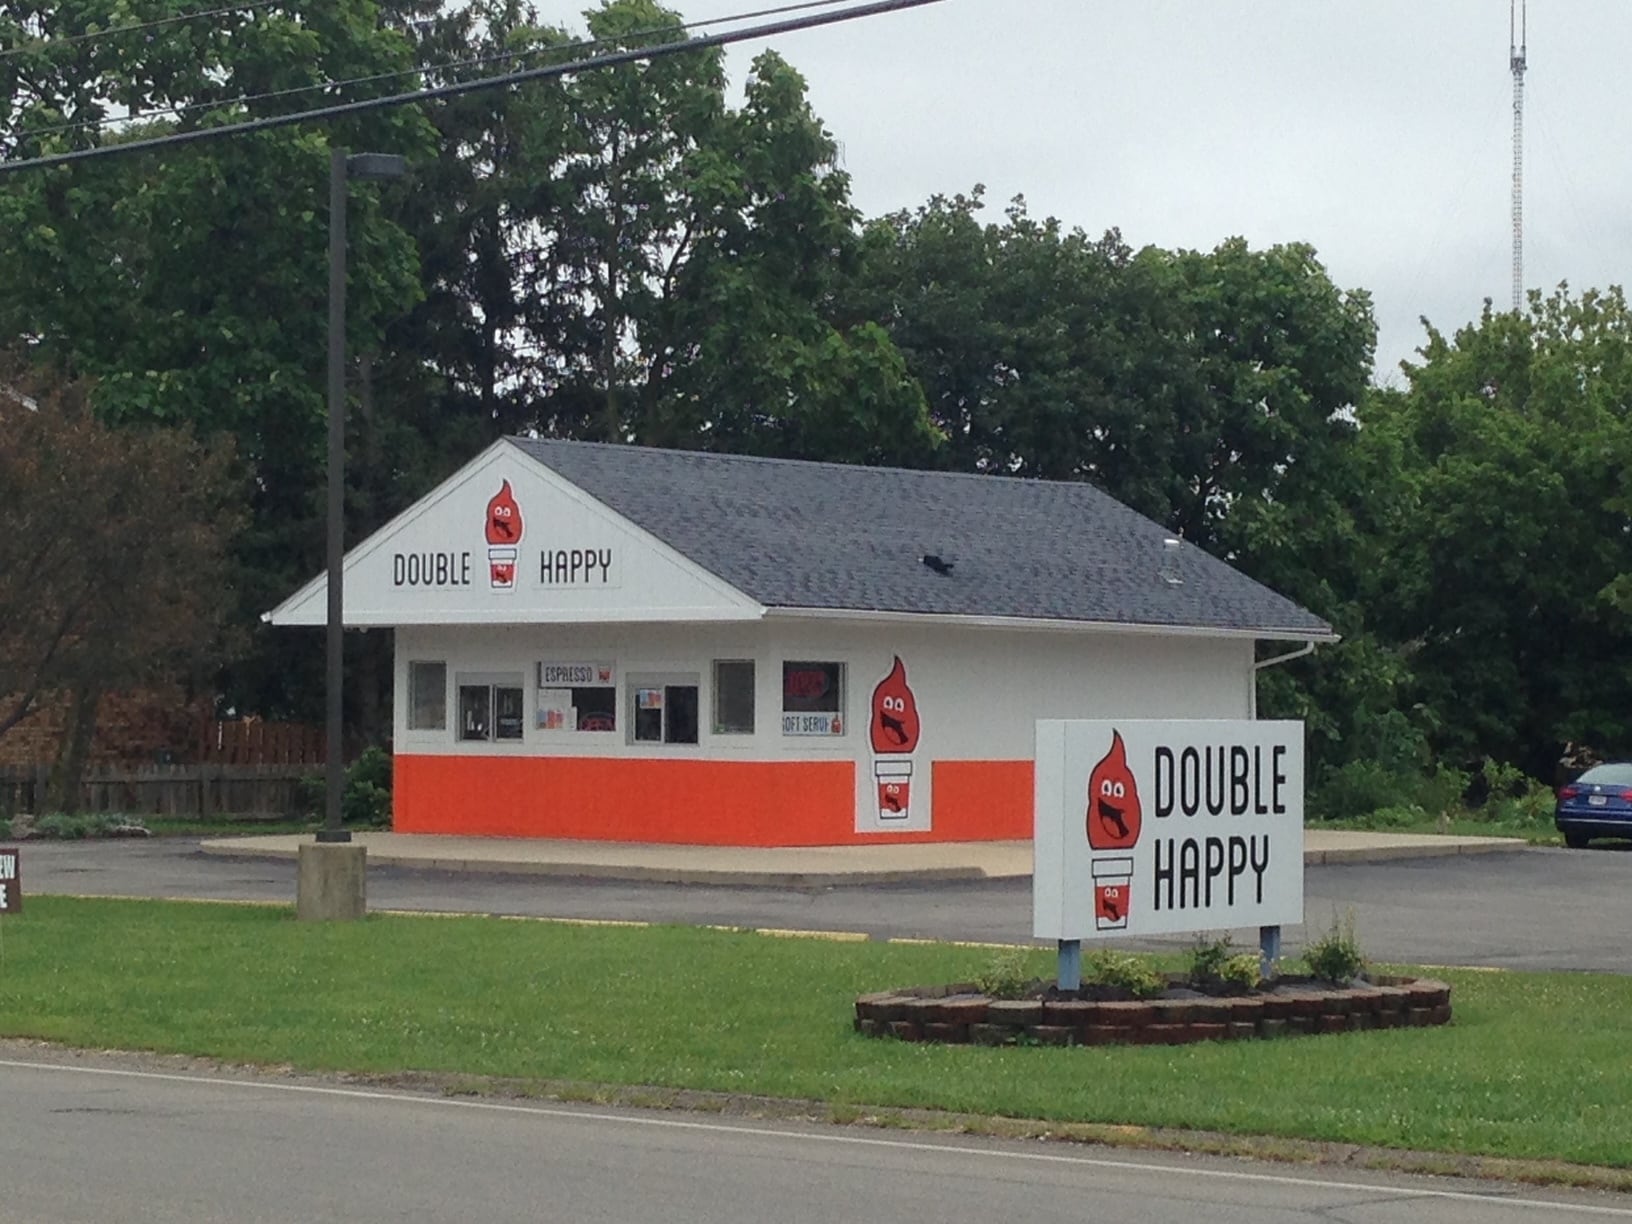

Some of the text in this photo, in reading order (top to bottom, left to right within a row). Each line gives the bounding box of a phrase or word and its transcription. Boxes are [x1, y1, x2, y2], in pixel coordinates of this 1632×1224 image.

[393, 548, 612, 586] DOUBLE HAPPY
[545, 666, 593, 682] ESPRESSO
[1154, 745, 1287, 818] DOUBLE
[1154, 834, 1269, 911] HAPPY
